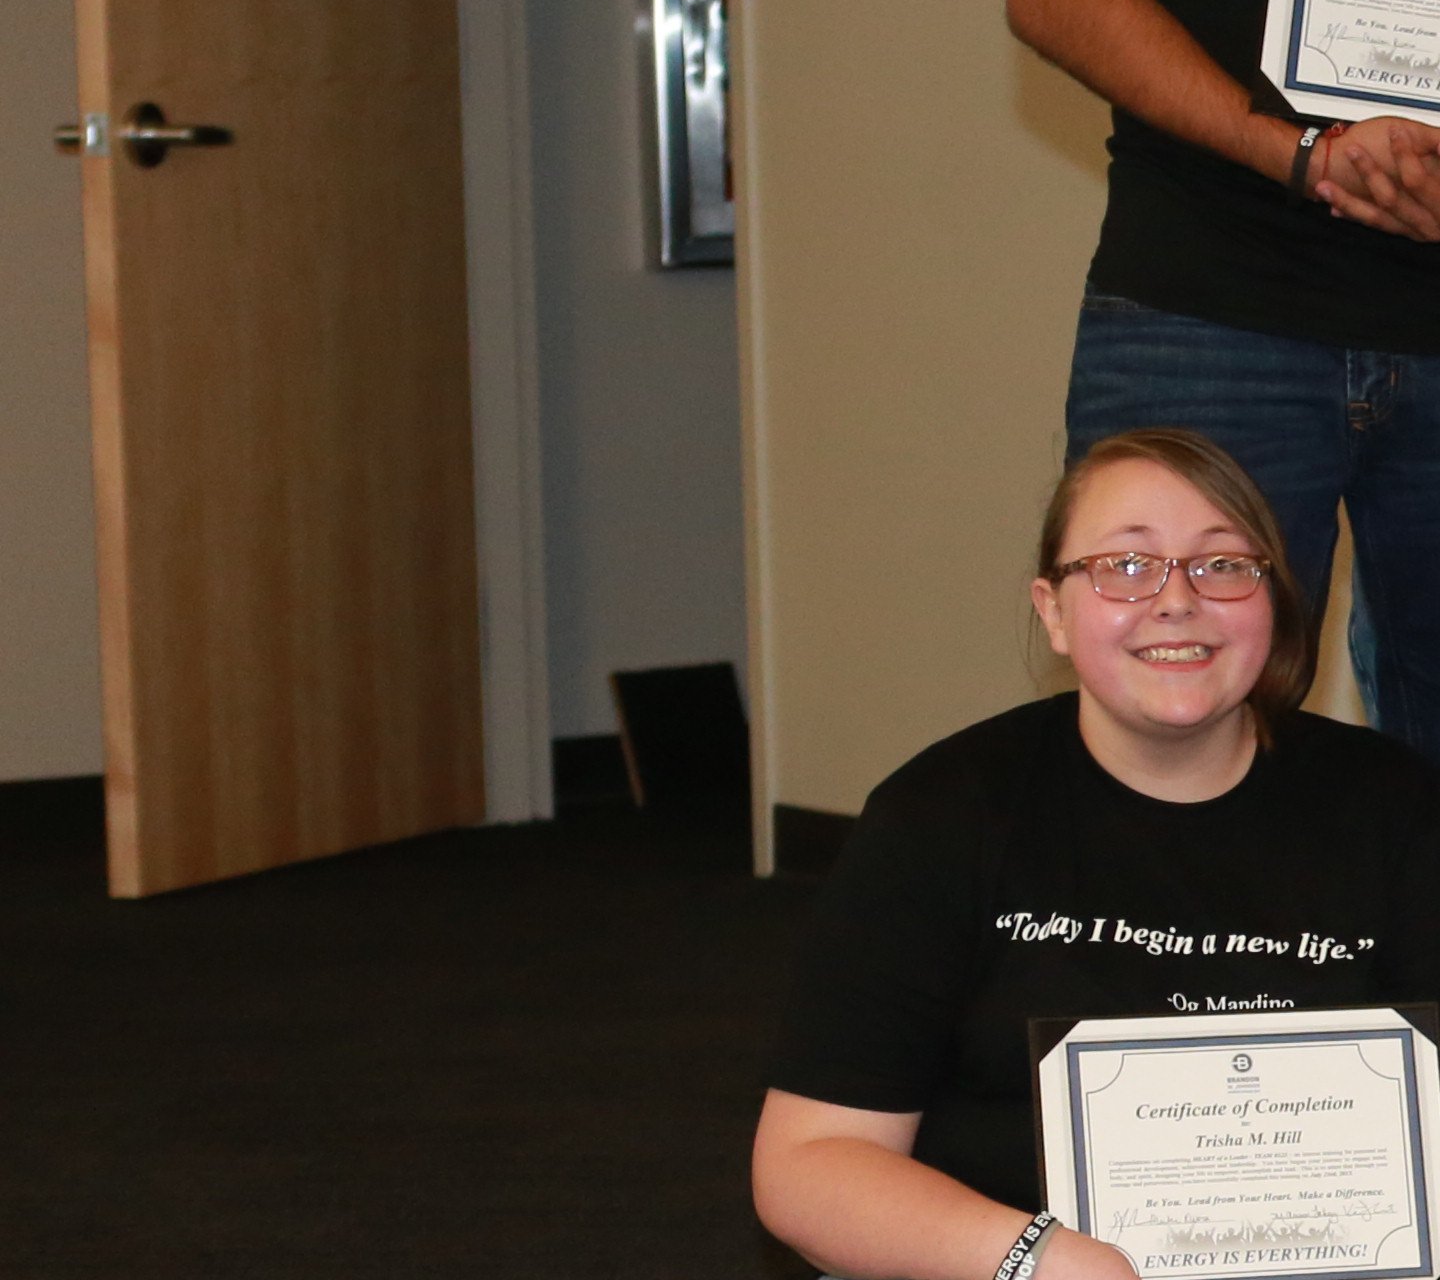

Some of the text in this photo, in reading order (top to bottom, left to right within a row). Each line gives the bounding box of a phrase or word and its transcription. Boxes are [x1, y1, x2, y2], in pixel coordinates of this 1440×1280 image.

[1089, 919, 1106, 942] I
[1114, 920, 1193, 955] begin
[1202, 935, 1216, 954] a
[1226, 935, 1289, 954] new
[1136, 1096, 1353, 1121] Certificate of Completion
[1022, 1224, 1042, 1243] IS
